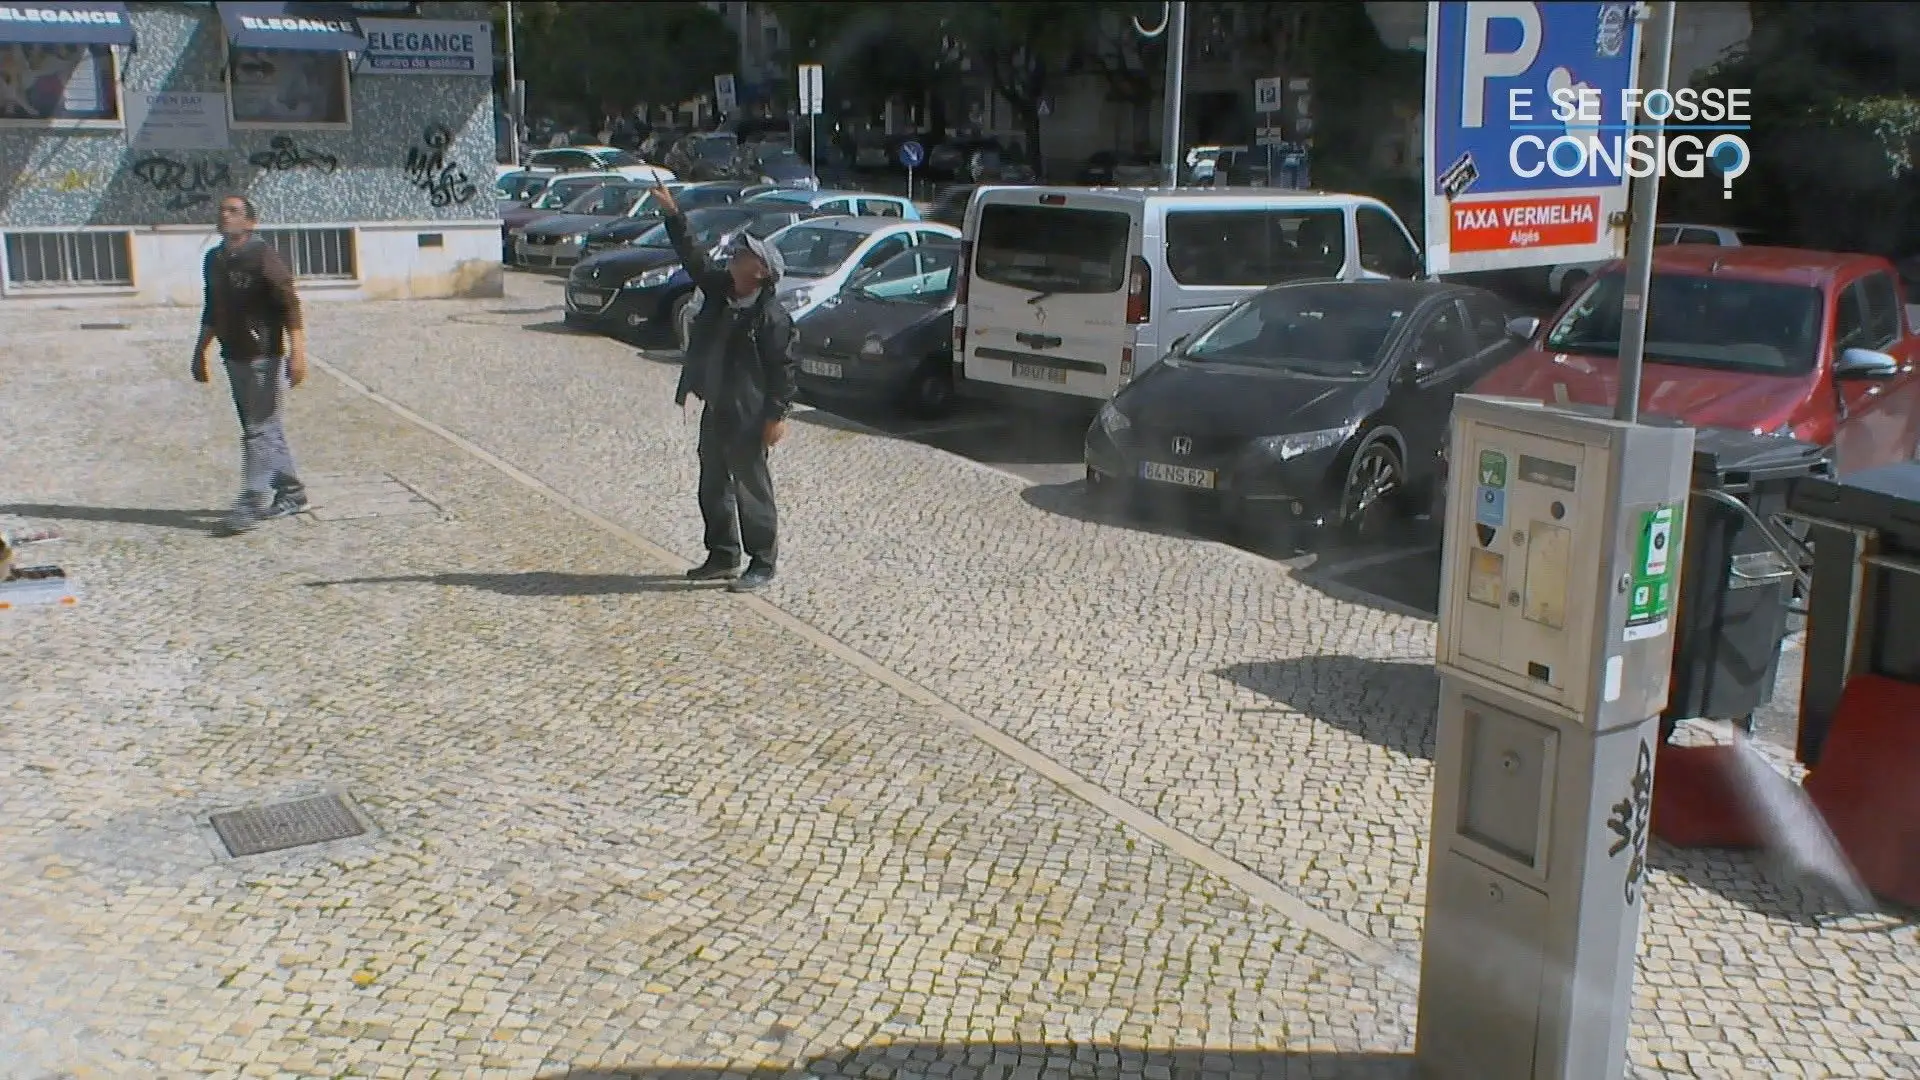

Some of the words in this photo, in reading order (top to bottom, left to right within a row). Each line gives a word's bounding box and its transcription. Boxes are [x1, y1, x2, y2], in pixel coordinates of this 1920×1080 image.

[241, 16, 353, 32] ELEGANCE
[368, 32, 474, 52] ELEGANCE
[1462, 1, 1542, 128] P
[1454, 208, 1499, 231] TAXA
[1503, 204, 1593, 227] VERMELHA
